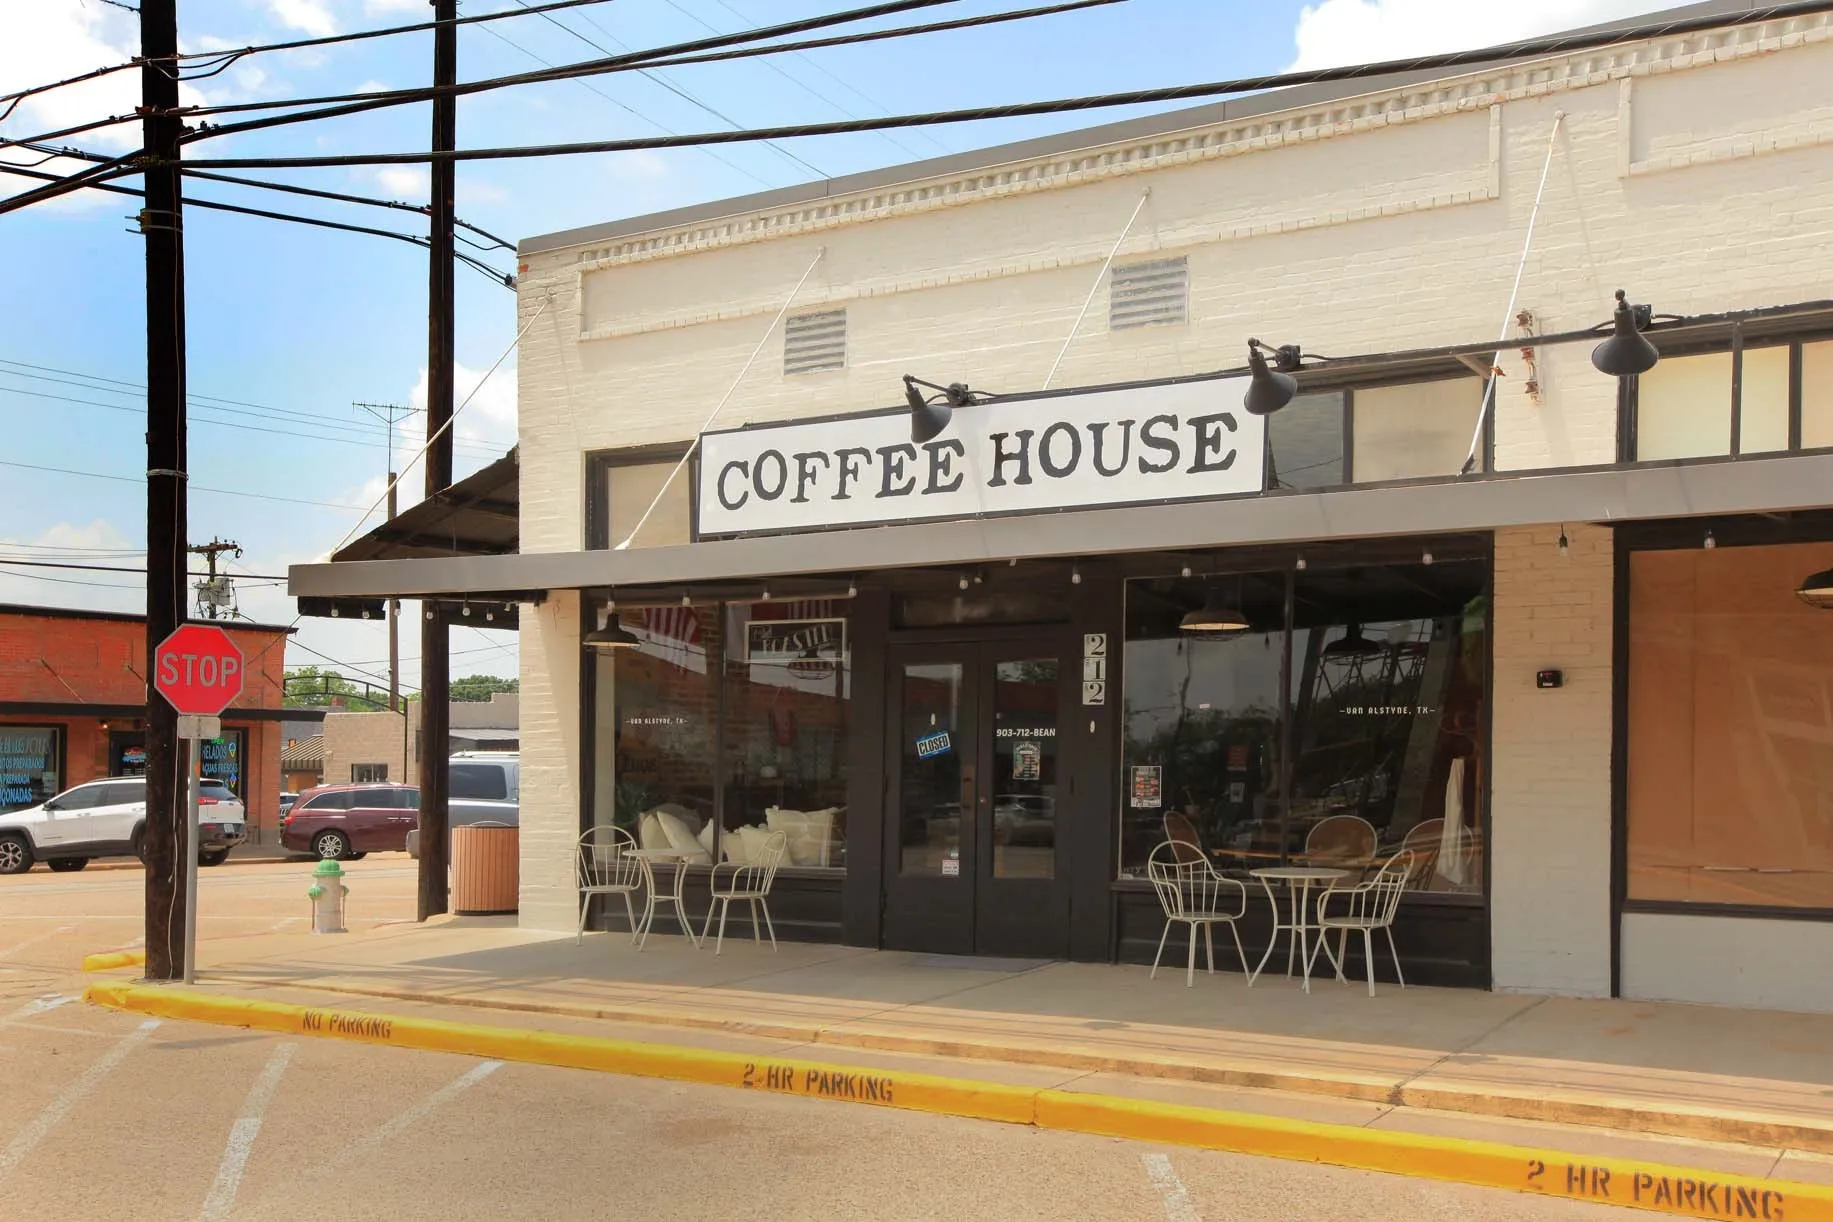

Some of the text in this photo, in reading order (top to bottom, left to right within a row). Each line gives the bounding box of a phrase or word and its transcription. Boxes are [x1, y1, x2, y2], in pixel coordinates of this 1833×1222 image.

[717, 412, 1238, 511] COFFEE HOUSE
[161, 652, 239, 687] STOP
[919, 736, 949, 755] CLOSED
[996, 728, 1056, 737] 903-712-BEAN
[303, 1011, 392, 1038] NO PARKING
[743, 1063, 893, 1102] 2 HR PARKING
[1527, 1160, 1784, 1221] 2 HR PARKING
